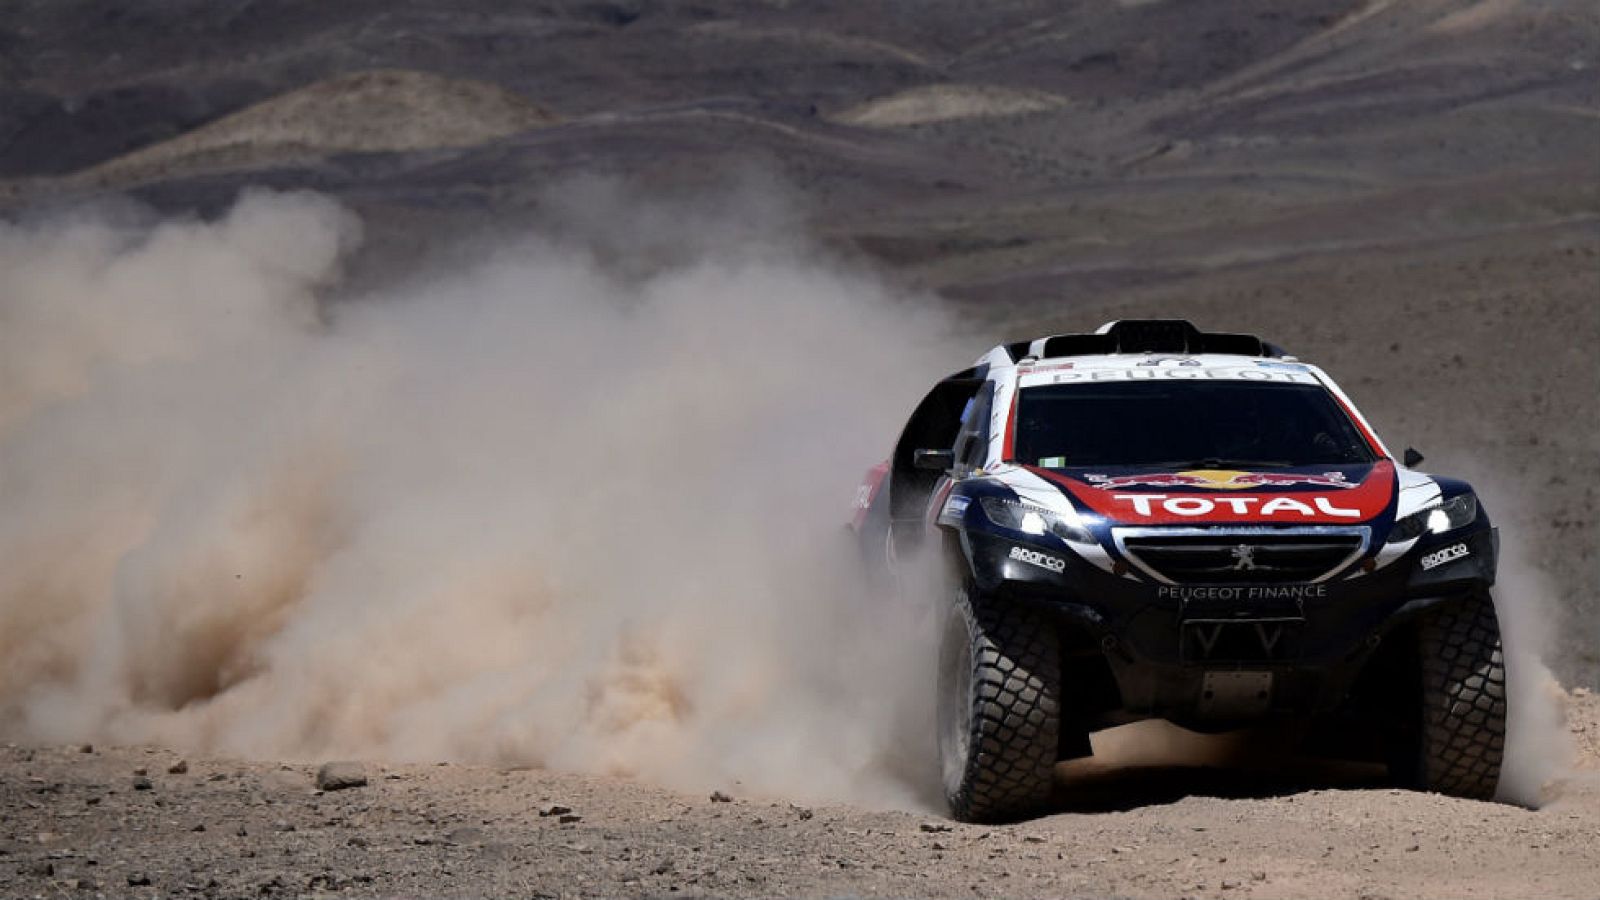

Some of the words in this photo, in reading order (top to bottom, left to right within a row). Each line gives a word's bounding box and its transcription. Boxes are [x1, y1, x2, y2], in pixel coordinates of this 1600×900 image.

[1053, 367, 1303, 383] PEUGEOT
[1114, 494, 1361, 517] TOTAL
[1009, 547, 1065, 573] sparco
[1421, 543, 1470, 570] sparco
[1158, 586, 1244, 600] PEUGEOT
[1248, 584, 1328, 598] FINANCE
